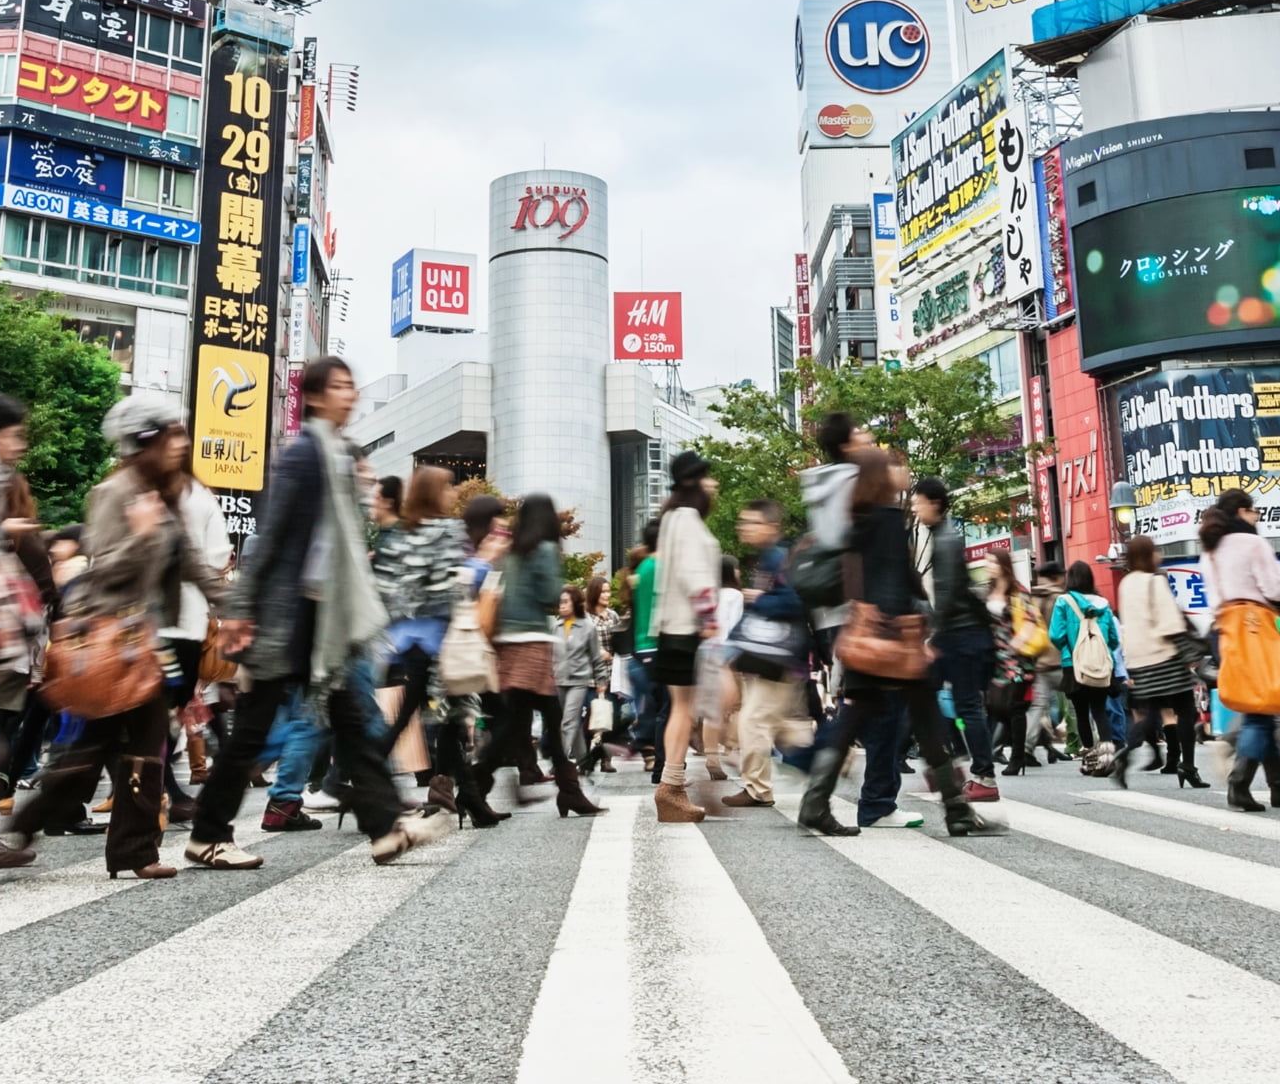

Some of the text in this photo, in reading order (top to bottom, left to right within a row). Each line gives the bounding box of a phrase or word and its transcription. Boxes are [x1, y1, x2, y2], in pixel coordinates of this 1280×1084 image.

[19, 60, 162, 119] コンタクト
[22, 113, 36, 125] 7F
[819, 115, 873, 125] MasterCard
[220, 124, 271, 174] 29
[1065, 133, 1164, 171] Mighty Vision SHIBUYA
[12, 189, 63, 214] AEON
[526, 185, 587, 197] SHIBUYA
[998, 118, 1032, 286] もんじゃ
[73, 200, 196, 238] 英会話イーオン
[510, 194, 590, 240] 109
[216, 192, 264, 294] 開幕
[1120, 239, 1235, 278] クロッシング
[426, 267, 461, 288] UNI
[1143, 264, 1209, 282] crossing
[204, 295, 269, 324] 日本 VS
[425, 289, 464, 310] QLO
[627, 299, 669, 327] H&M
[203, 319, 268, 346] ポーランド
[643, 342, 675, 353] 150m
[1136, 390, 1160, 428] Soul
[1159, 386, 1255, 423] Brothers
[201, 436, 258, 462] 世界バレー
[1142, 444, 1166, 482] Soul
[1165, 439, 1260, 476] Brothers
[214, 462, 243, 474] JAPAN
[222, 517, 257, 535] 放送
